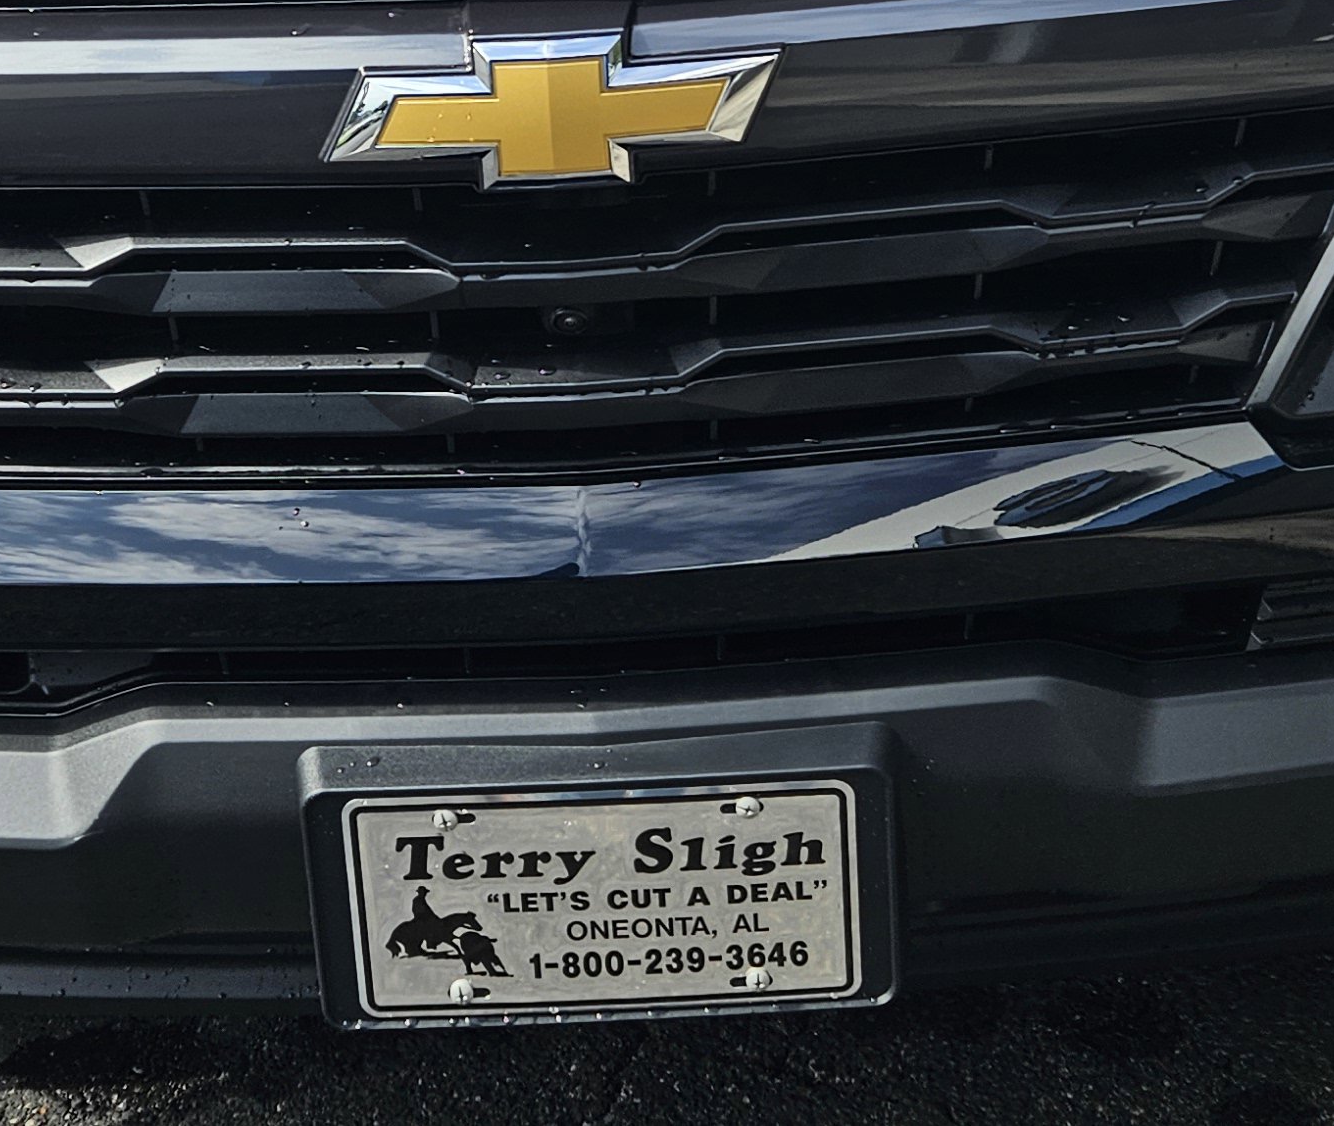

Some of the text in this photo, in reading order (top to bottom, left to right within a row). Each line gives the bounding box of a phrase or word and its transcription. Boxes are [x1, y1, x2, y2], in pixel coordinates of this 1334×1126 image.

[395, 826, 826, 885] Terry Sligh
[487, 879, 828, 913] "LET'S CUT A DEAL"
[566, 912, 770, 941] ONEONTA, AL
[529, 940, 810, 979] 1-800-239-3646
